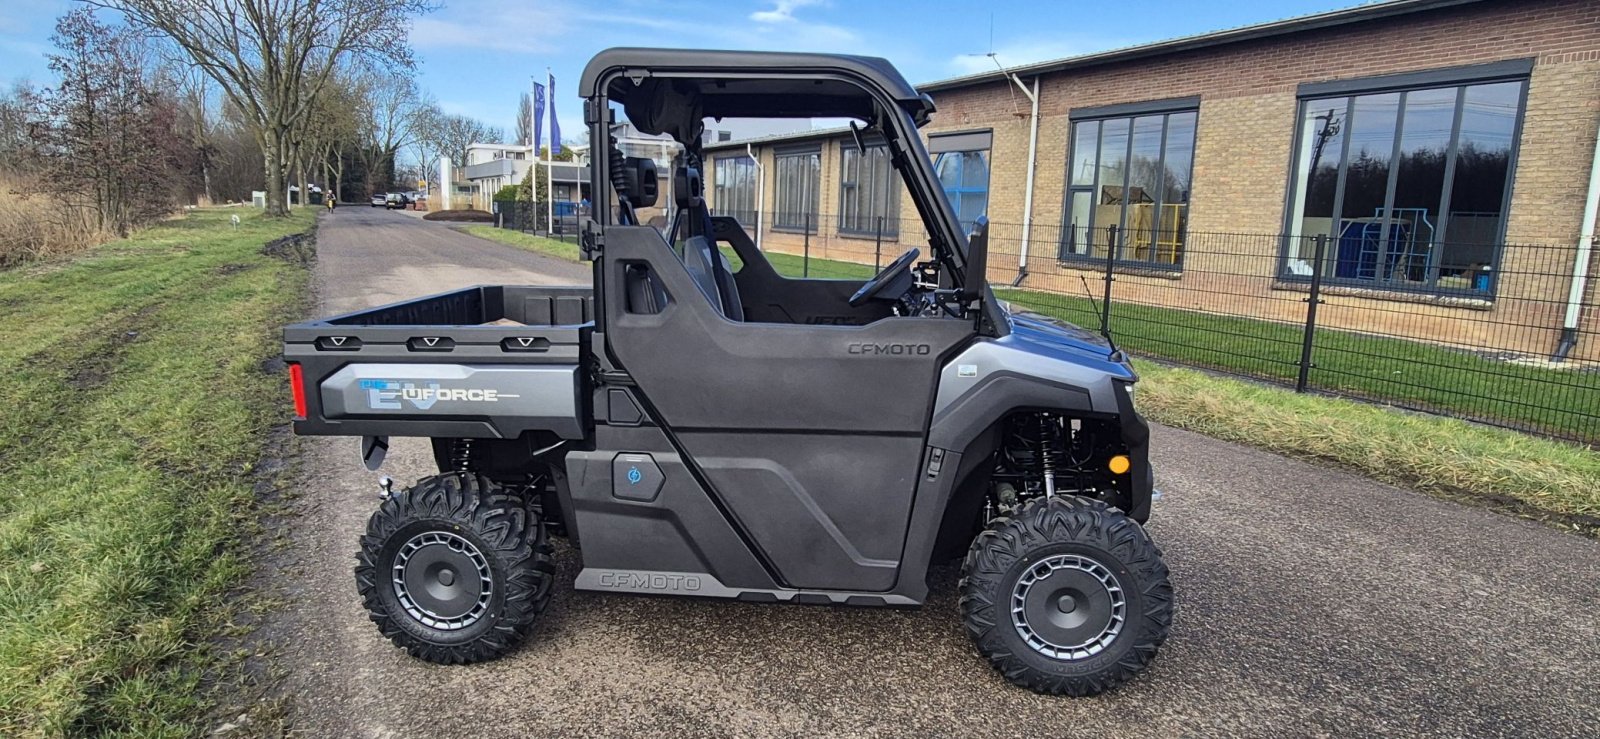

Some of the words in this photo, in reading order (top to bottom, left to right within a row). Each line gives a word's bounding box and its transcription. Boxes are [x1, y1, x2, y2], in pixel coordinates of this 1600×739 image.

[848, 342, 931, 356] CFMOTO
[402, 388, 498, 402] UFORCE
[599, 572, 701, 592] CFMOTO
